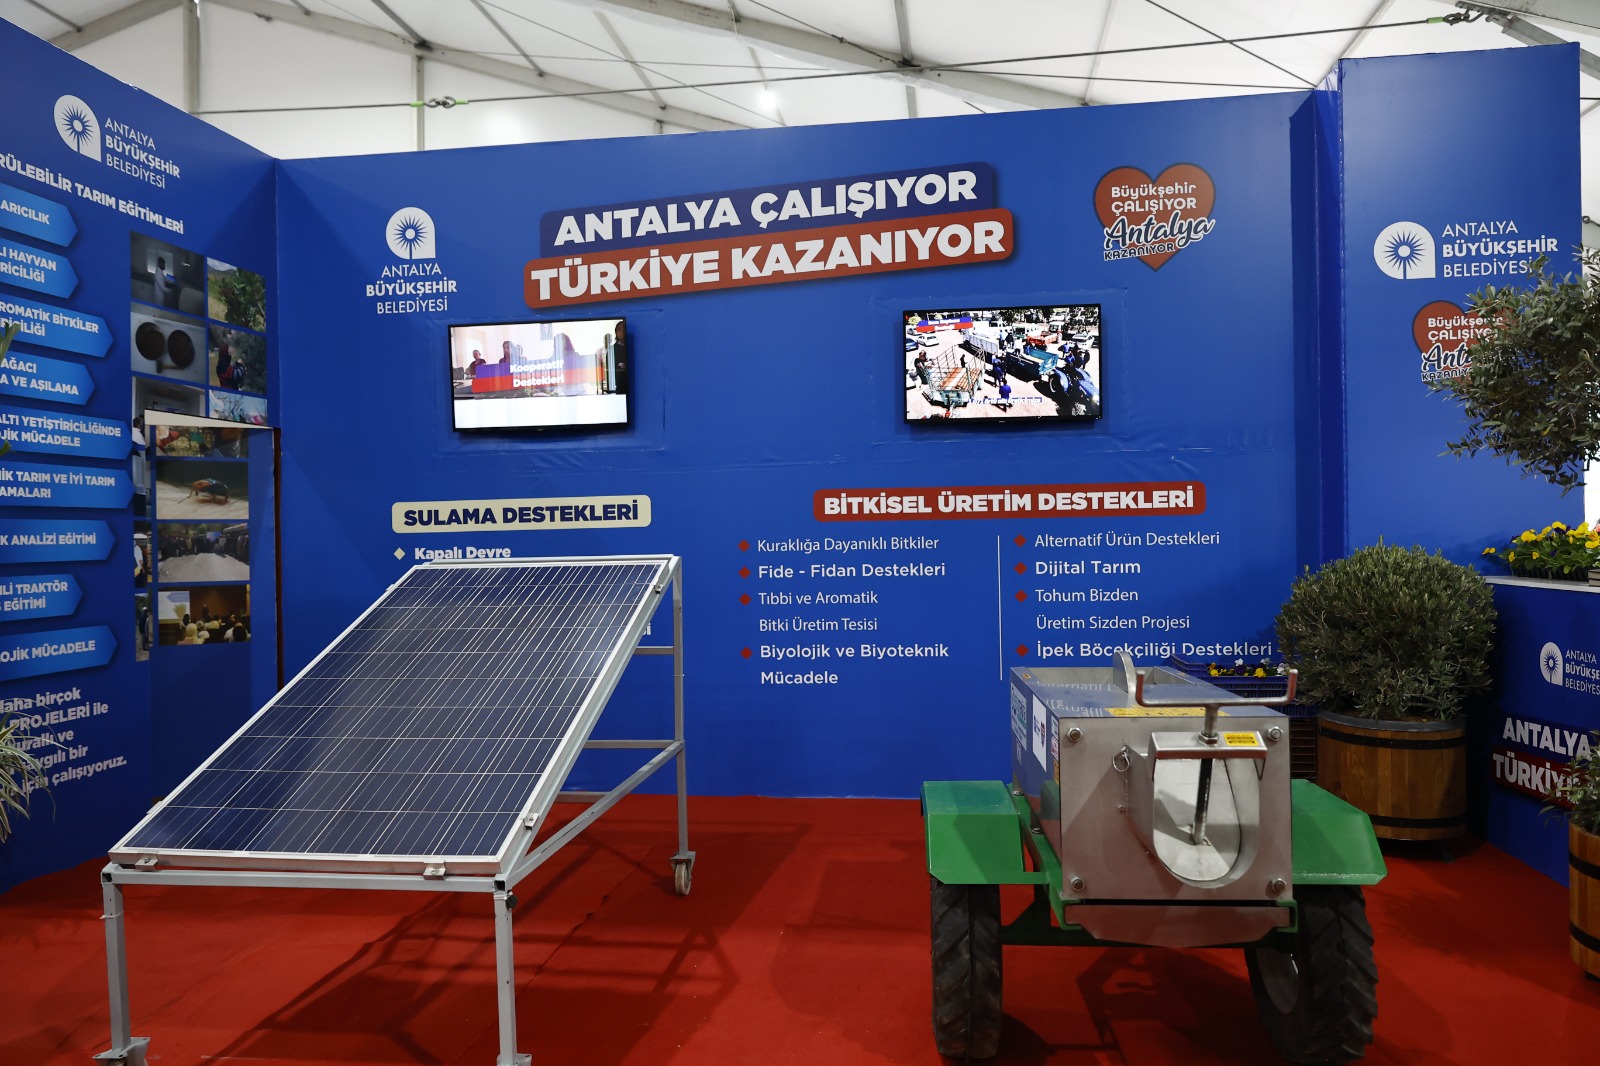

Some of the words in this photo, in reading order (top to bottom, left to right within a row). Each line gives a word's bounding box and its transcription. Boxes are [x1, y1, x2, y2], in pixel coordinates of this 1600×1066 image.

[105, 117, 156, 150] ANTALYA
[105, 134, 180, 178] BÜYÜKŞEHİR
[106, 154, 166, 189] BELEDİYESİ
[1111, 182, 1197, 200] Büyükşehir
[1, 200, 50, 225] ARICILIK
[74, 182, 116, 210] TARIM
[119, 198, 184, 234] EĞİTİMLERİ
[554, 198, 741, 247] ANTALYA
[751, 170, 977, 229] ÇALIŞIYOR
[1111, 197, 1197, 216] ÇALIŞIYOR
[1104, 210, 1216, 250] Antalya
[1441, 220, 1519, 238] ANTALYA
[1104, 241, 1176, 261] KAZANIYOR
[1442, 235, 1559, 258] BÜYÜKŞEHİR
[9, 248, 57, 271] HAYVAN
[531, 248, 720, 302] TÜRKİYE
[731, 219, 1005, 280] KAZANIYOR
[0, 261, 45, 284] RİCİLİĞİ
[381, 262, 442, 278] ANTALYA
[366, 277, 457, 298] BÜYÜKŞEHİR
[377, 296, 448, 314] BELEDİYESİ
[0, 302, 50, 323] ROMATİK
[52, 313, 99, 333] BİTKİLER
[1, 357, 37, 373] AĞACI
[510, 359, 564, 374] Kooperatif
[513, 374, 564, 388] Destekleri
[1421, 367, 1473, 382] KAZANIY
[11, 375, 27, 387] VE
[30, 378, 79, 395] AŞILAMA
[21, 416, 121, 437] YETİŞTİRİCİLİĞİNDE
[0, 428, 19, 441] JİK
[21, 430, 81, 447] MÜCADELE
[0, 468, 13, 481] İK
[16, 472, 51, 483] TARIM
[53, 474, 67, 484] VE
[70, 472, 83, 485] İYİ
[85, 476, 115, 486] TARIM
[0, 486, 51, 498] AMALARI
[824, 491, 932, 515] BİTKİSEL
[938, 490, 1032, 512] ÜRETİM
[1038, 485, 1194, 511] DESTEKLERİ
[404, 507, 497, 526] SULAMA
[502, 499, 639, 523] DESTEKLERİ
[11, 533, 57, 545] ANALİZİ
[58, 532, 96, 545] EĞİTİMİ
[758, 538, 820, 554] Kuraklığa
[824, 537, 887, 553] Dayanıklı
[891, 537, 939, 550] Bitkiler
[1034, 532, 1103, 548] Alternatif
[1106, 531, 1142, 546] Ürün
[1146, 531, 1220, 546] Destekleri
[414, 547, 462, 560] Kapalı
[466, 546, 511, 558] Devre
[758, 564, 794, 578] Fide
[811, 563, 856, 577] Fidan
[861, 562, 946, 577] Destekleri
[1035, 560, 1085, 577] Dijital
[1091, 560, 1141, 574] Tarım
[16, 580, 68, 595] TRAKTÖR
[1035, 588, 1085, 602] Tohum
[1089, 588, 1139, 601] Bizden
[4, 596, 46, 611] EĞİTİMİ
[758, 592, 792, 605] Tıbbi
[796, 594, 812, 604] ve
[815, 591, 878, 604] Aromatik
[759, 618, 789, 632] Bitki
[792, 616, 839, 631] Üretim
[841, 617, 878, 631] Tesisi
[1036, 614, 1085, 630] Üretim
[1089, 615, 1137, 629] Sizden
[1142, 615, 1190, 632] Projesi
[0, 647, 30, 663] OJİK
[32, 640, 96, 658] MÜCADELE
[760, 644, 830, 661] Biyolojik
[836, 646, 855, 657] ve
[860, 643, 949, 660] Biyoteknik
[1037, 640, 1074, 658] İpek
[1182, 641, 1272, 657] Destekleri
[1565, 649, 1597, 665] ANTALYA
[761, 670, 839, 684] Mücadele
[1565, 663, 1600, 681] BÜYÜKŞE
[36, 687, 81, 707] birçok
[10, 702, 90, 731] PROJELERİ
[93, 702, 109, 715] ile
[58, 730, 74, 743] ve
[1503, 717, 1593, 762] ANTALYA
[69, 744, 89, 759] bir
[52, 756, 127, 786] çalışıyoruz.
